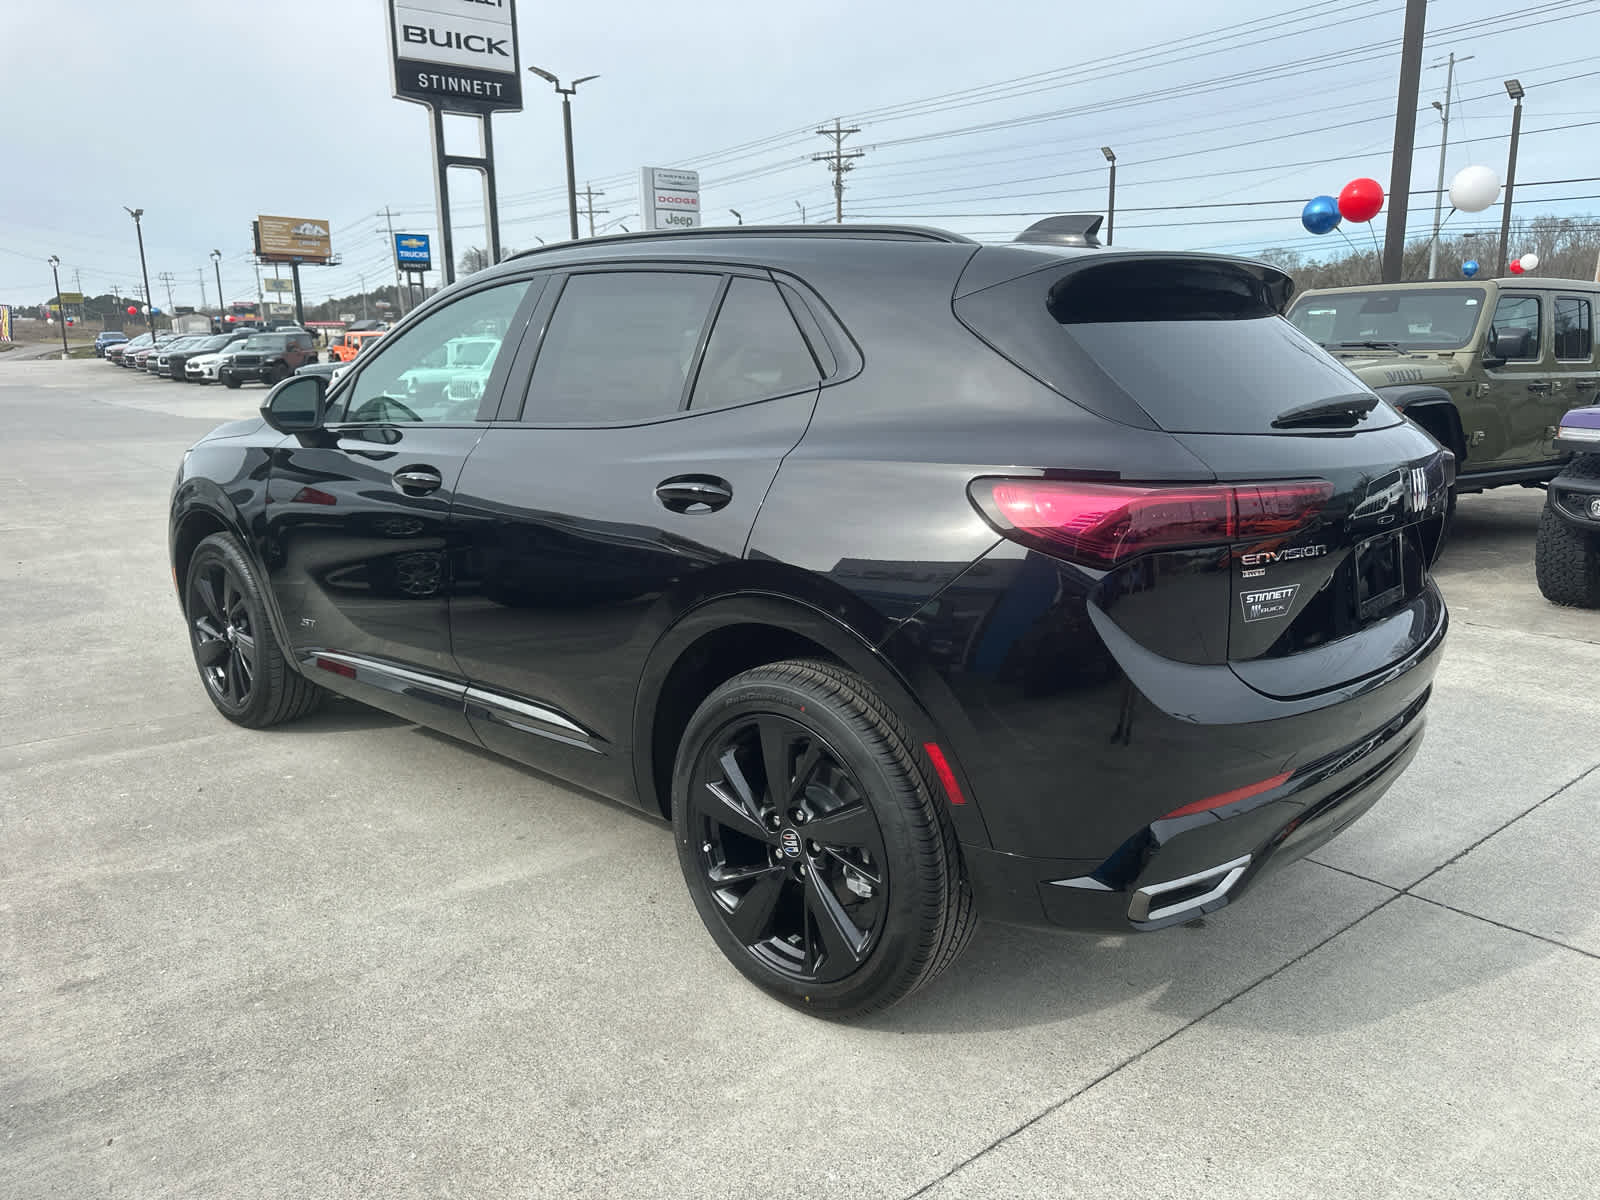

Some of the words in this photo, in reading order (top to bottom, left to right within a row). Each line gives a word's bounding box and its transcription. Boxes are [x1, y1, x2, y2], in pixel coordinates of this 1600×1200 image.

[403, 24, 510, 57] BUICK
[418, 73, 503, 97] STINNETT
[657, 195, 697, 205] DODGE
[665, 212, 693, 227] Jeep
[400, 250, 429, 258] TRUCKS
[1246, 588, 1294, 604] STINNETT
[1260, 605, 1285, 614] BUICK
